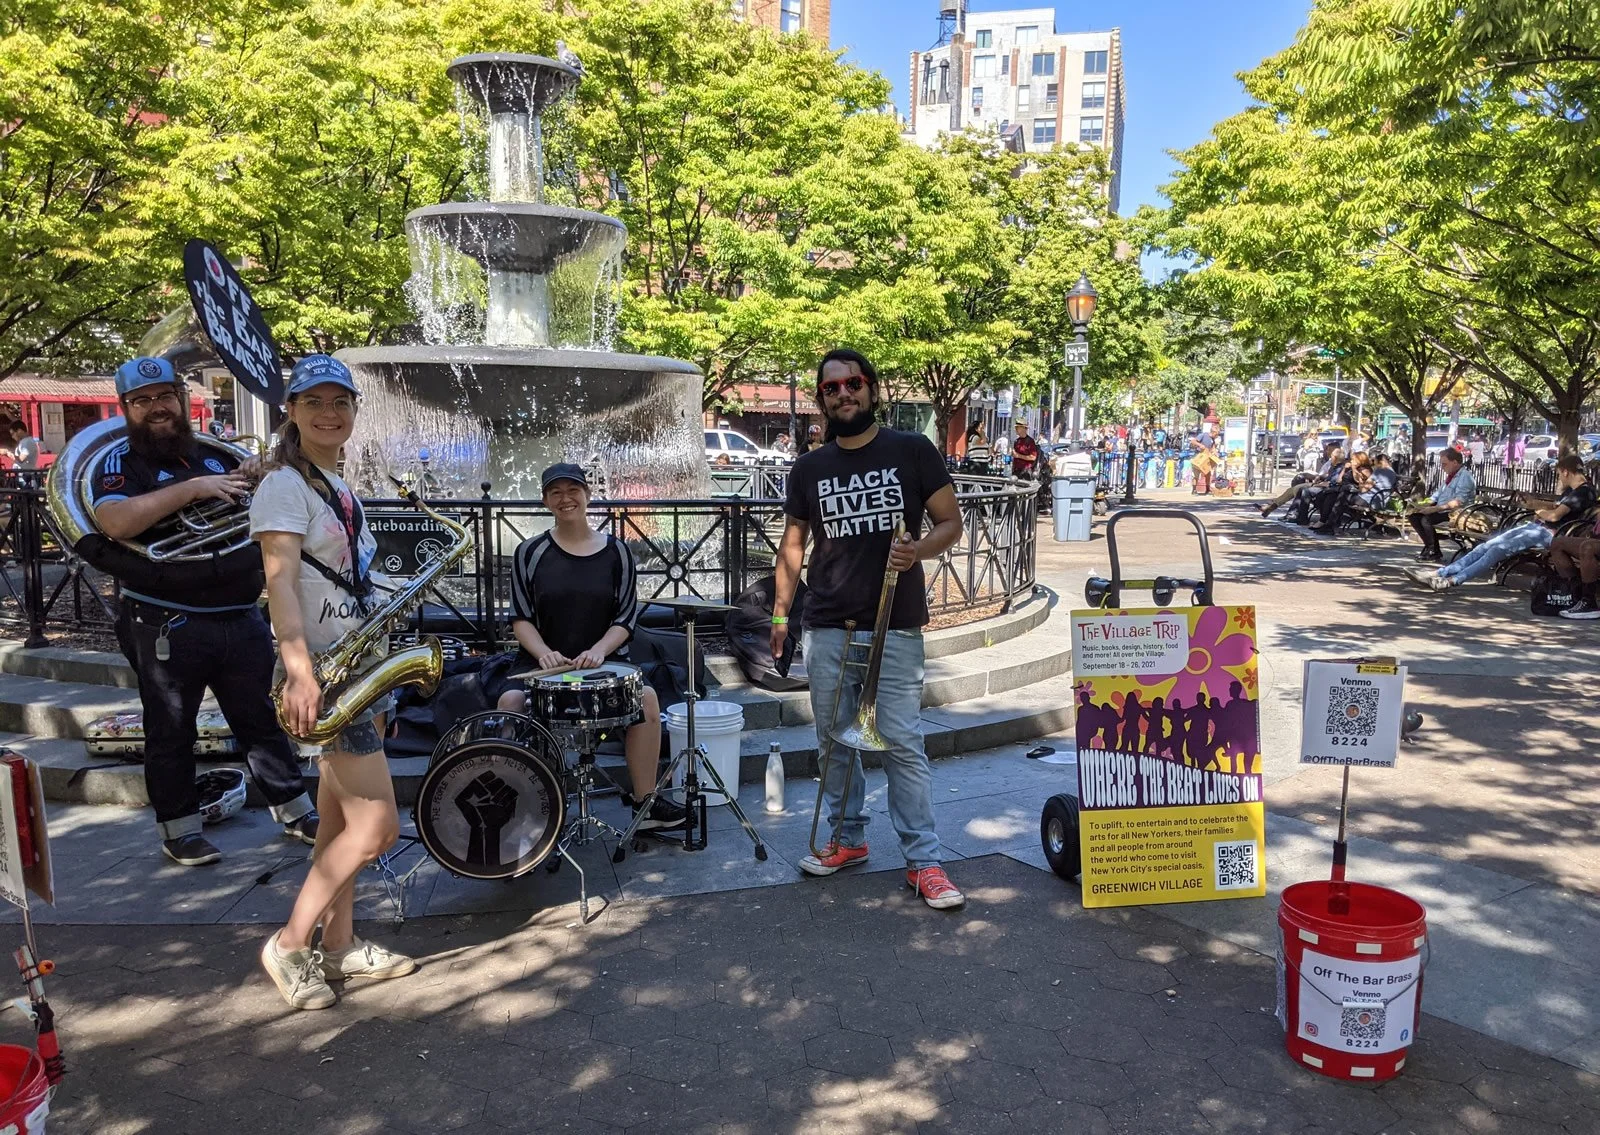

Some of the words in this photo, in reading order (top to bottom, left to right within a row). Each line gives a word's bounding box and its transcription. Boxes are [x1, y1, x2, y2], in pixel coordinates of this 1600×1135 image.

[203, 246, 251, 316] OFF
[203, 303, 269, 388] BRASS
[232, 305, 276, 374] BAR
[304, 358, 329, 370] NIAGARA
[818, 468, 900, 497] BLACK
[820, 488, 902, 518] LIVES
[823, 512, 904, 539] MATTER
[1122, 643, 1142, 652] design,
[1143, 643, 1164, 651] history,
[1083, 662, 1117, 670] September
[1340, 678, 1372, 686] Venmo
[1304, 755, 1391, 767] @OffTheBarBrass
[449, 759, 475, 779] UNITED
[528, 774, 539, 785] BE
[1080, 749, 1138, 808] WHERE
[1140, 754, 1164, 806] THE
[1166, 760, 1202, 804] BEAT
[1204, 771, 1240, 804] LIVES
[1243, 776, 1258, 801] ON
[433, 781, 448, 806] PEOPLE
[432, 808, 441, 822] THE
[1101, 820, 1125, 831] uplift,
[1136, 818, 1172, 827] entertain
[1174, 817, 1188, 826] and
[1199, 816, 1235, 824] celebrate
[1090, 833, 1105, 842] arts
[1107, 832, 1119, 840] for
[1121, 831, 1130, 840] all
[1132, 831, 1149, 839] New
[1150, 829, 1184, 838] Yorkers,
[1204, 826, 1234, 835] families
[1107, 843, 1116, 852] all
[1117, 843, 1144, 854] people
[1166, 840, 1193, 849] around
[1091, 856, 1104, 864] the
[1106, 854, 1128, 863] world
[1130, 854, 1146, 862] who
[1091, 867, 1108, 875] New
[1130, 865, 1152, 874] City's
[1153, 863, 1181, 874] special
[1092, 881, 1157, 894] GREENWICH
[1159, 878, 1203, 890] VILLAGE
[1313, 966, 1332, 978] Off
[1336, 972, 1359, 984] The
[1362, 976, 1384, 985] Bar
[1387, 972, 1412, 984] Brass
[1346, 1039, 1378, 1048] 8224
